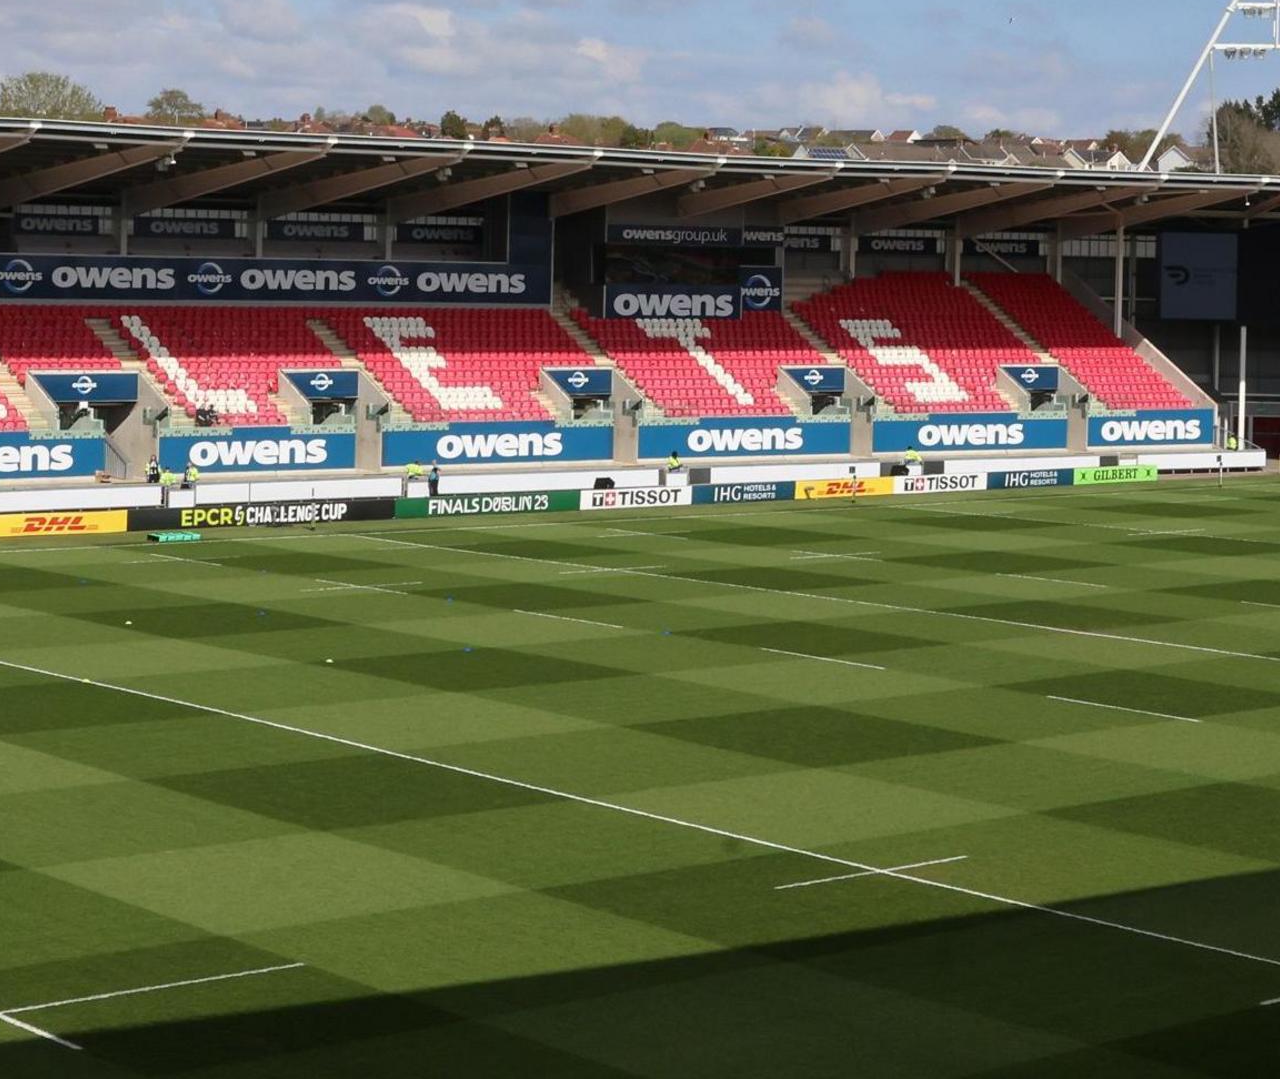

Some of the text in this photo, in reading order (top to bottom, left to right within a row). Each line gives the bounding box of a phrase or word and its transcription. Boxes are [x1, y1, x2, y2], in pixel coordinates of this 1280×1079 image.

[20, 216, 92, 231] owens
[150, 219, 218, 234] owens
[283, 223, 349, 238] owens
[412, 226, 473, 241] owens
[622, 228, 727, 244] owensgroup.uk
[744, 231, 784, 242] wens
[871, 239, 925, 251] owens
[976, 242, 1027, 253] owens
[52, 264, 175, 291] owens
[187, 272, 232, 285] owens
[240, 267, 356, 292] owens
[367, 275, 409, 287] owens
[416, 269, 526, 294] owens
[613, 293, 733, 317] owens
[72, 381, 98, 389] owens
[567, 376, 590, 384] owens
[918, 423, 1024, 447] owens
[1101, 418, 1201, 442] owens
[437, 432, 563, 459] owens
[687, 427, 803, 453] owens
[189, 438, 327, 467] owens
[1004, 473, 1029, 487] IHG
[1030, 471, 1049, 479] HOTELS
[1030, 478, 1058, 486] RESORTS
[1093, 468, 1138, 481] GILBERT
[743, 483, 770, 492] HOTELS
[826, 482, 867, 495] DHL
[927, 475, 978, 490] TISSOT
[619, 489, 681, 505] TISSOT
[714, 486, 742, 502] IHG
[743, 491, 776, 500] RESORTS
[428, 495, 549, 516] FINALS DUBLIN 23
[181, 507, 233, 527] EPCR
[322, 502, 347, 520] CUP
[22, 516, 88, 534] DHL
